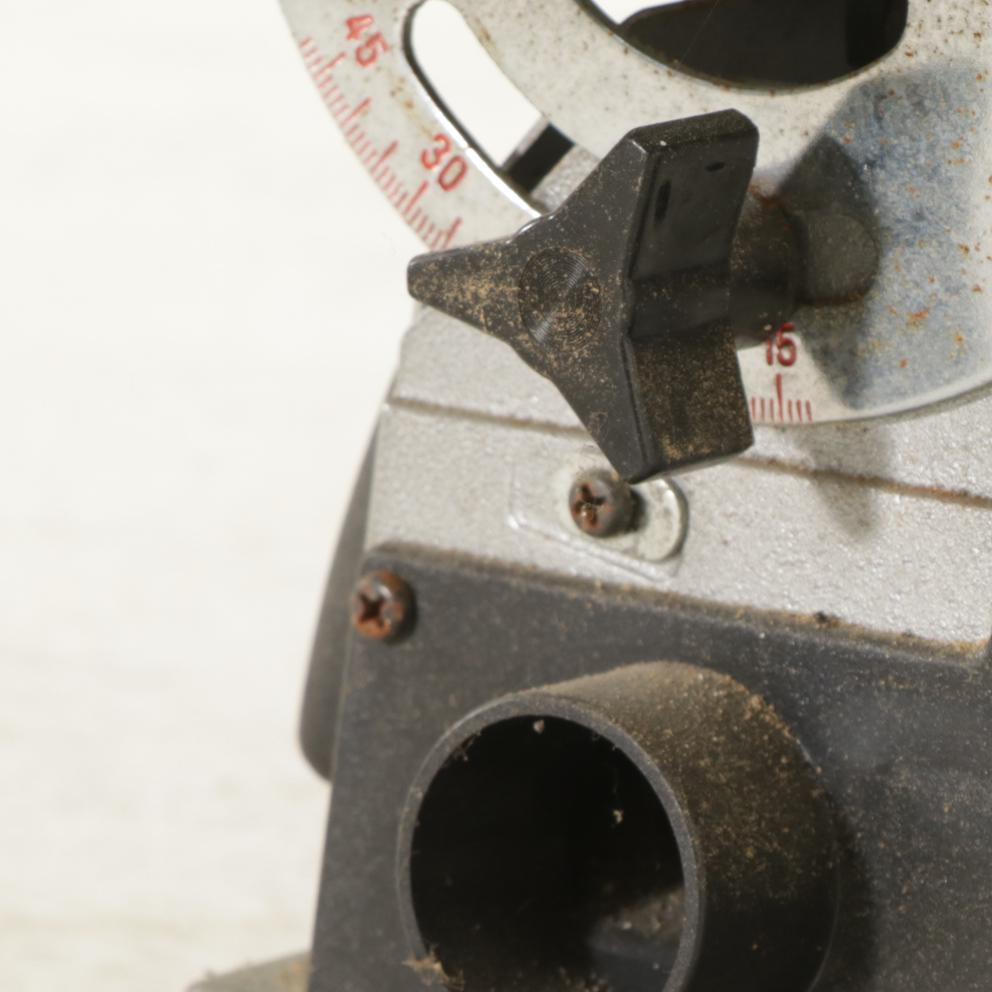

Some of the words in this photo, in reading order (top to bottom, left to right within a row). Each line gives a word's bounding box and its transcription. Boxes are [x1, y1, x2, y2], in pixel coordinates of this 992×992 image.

[345, 14, 389, 66] 45
[421, 133, 467, 191] 30
[766, 322, 797, 366] 15
